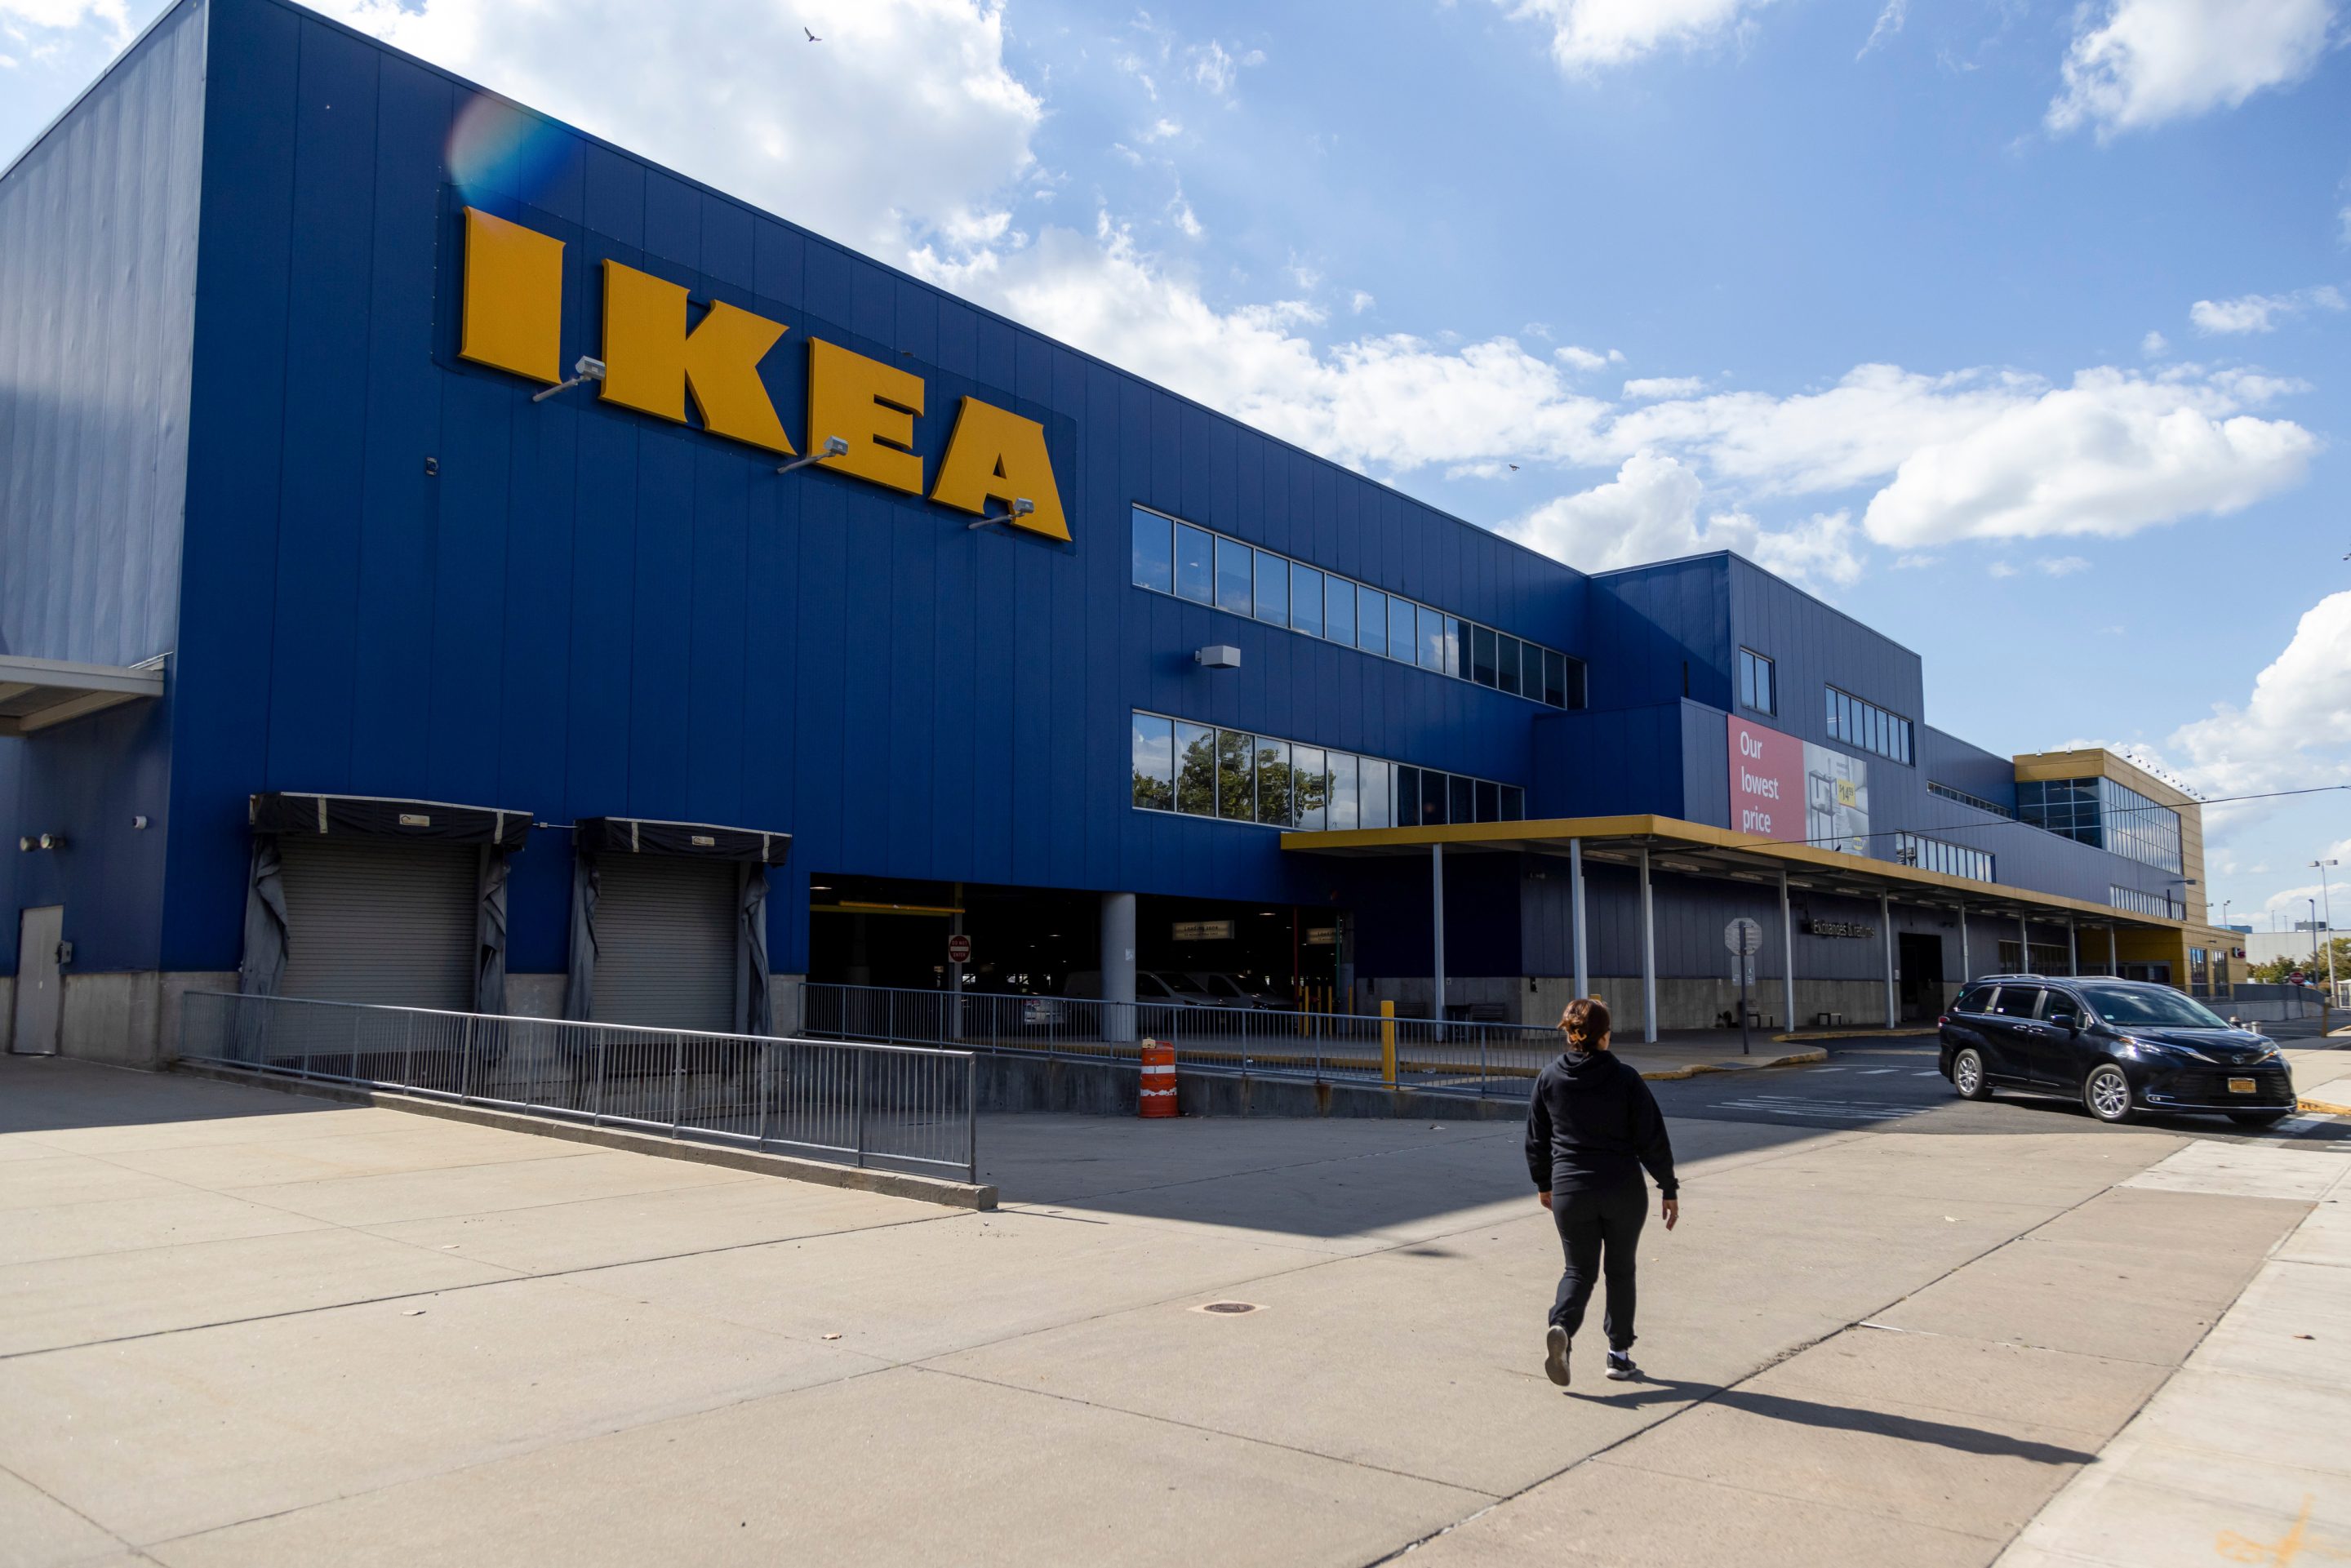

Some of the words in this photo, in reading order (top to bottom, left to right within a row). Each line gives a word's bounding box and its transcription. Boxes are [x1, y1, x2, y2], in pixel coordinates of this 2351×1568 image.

[459, 206, 1073, 542] IKEA
[1740, 731, 1762, 759] Our
[1741, 766, 1779, 800] lowest
[1743, 806, 1771, 833] price
